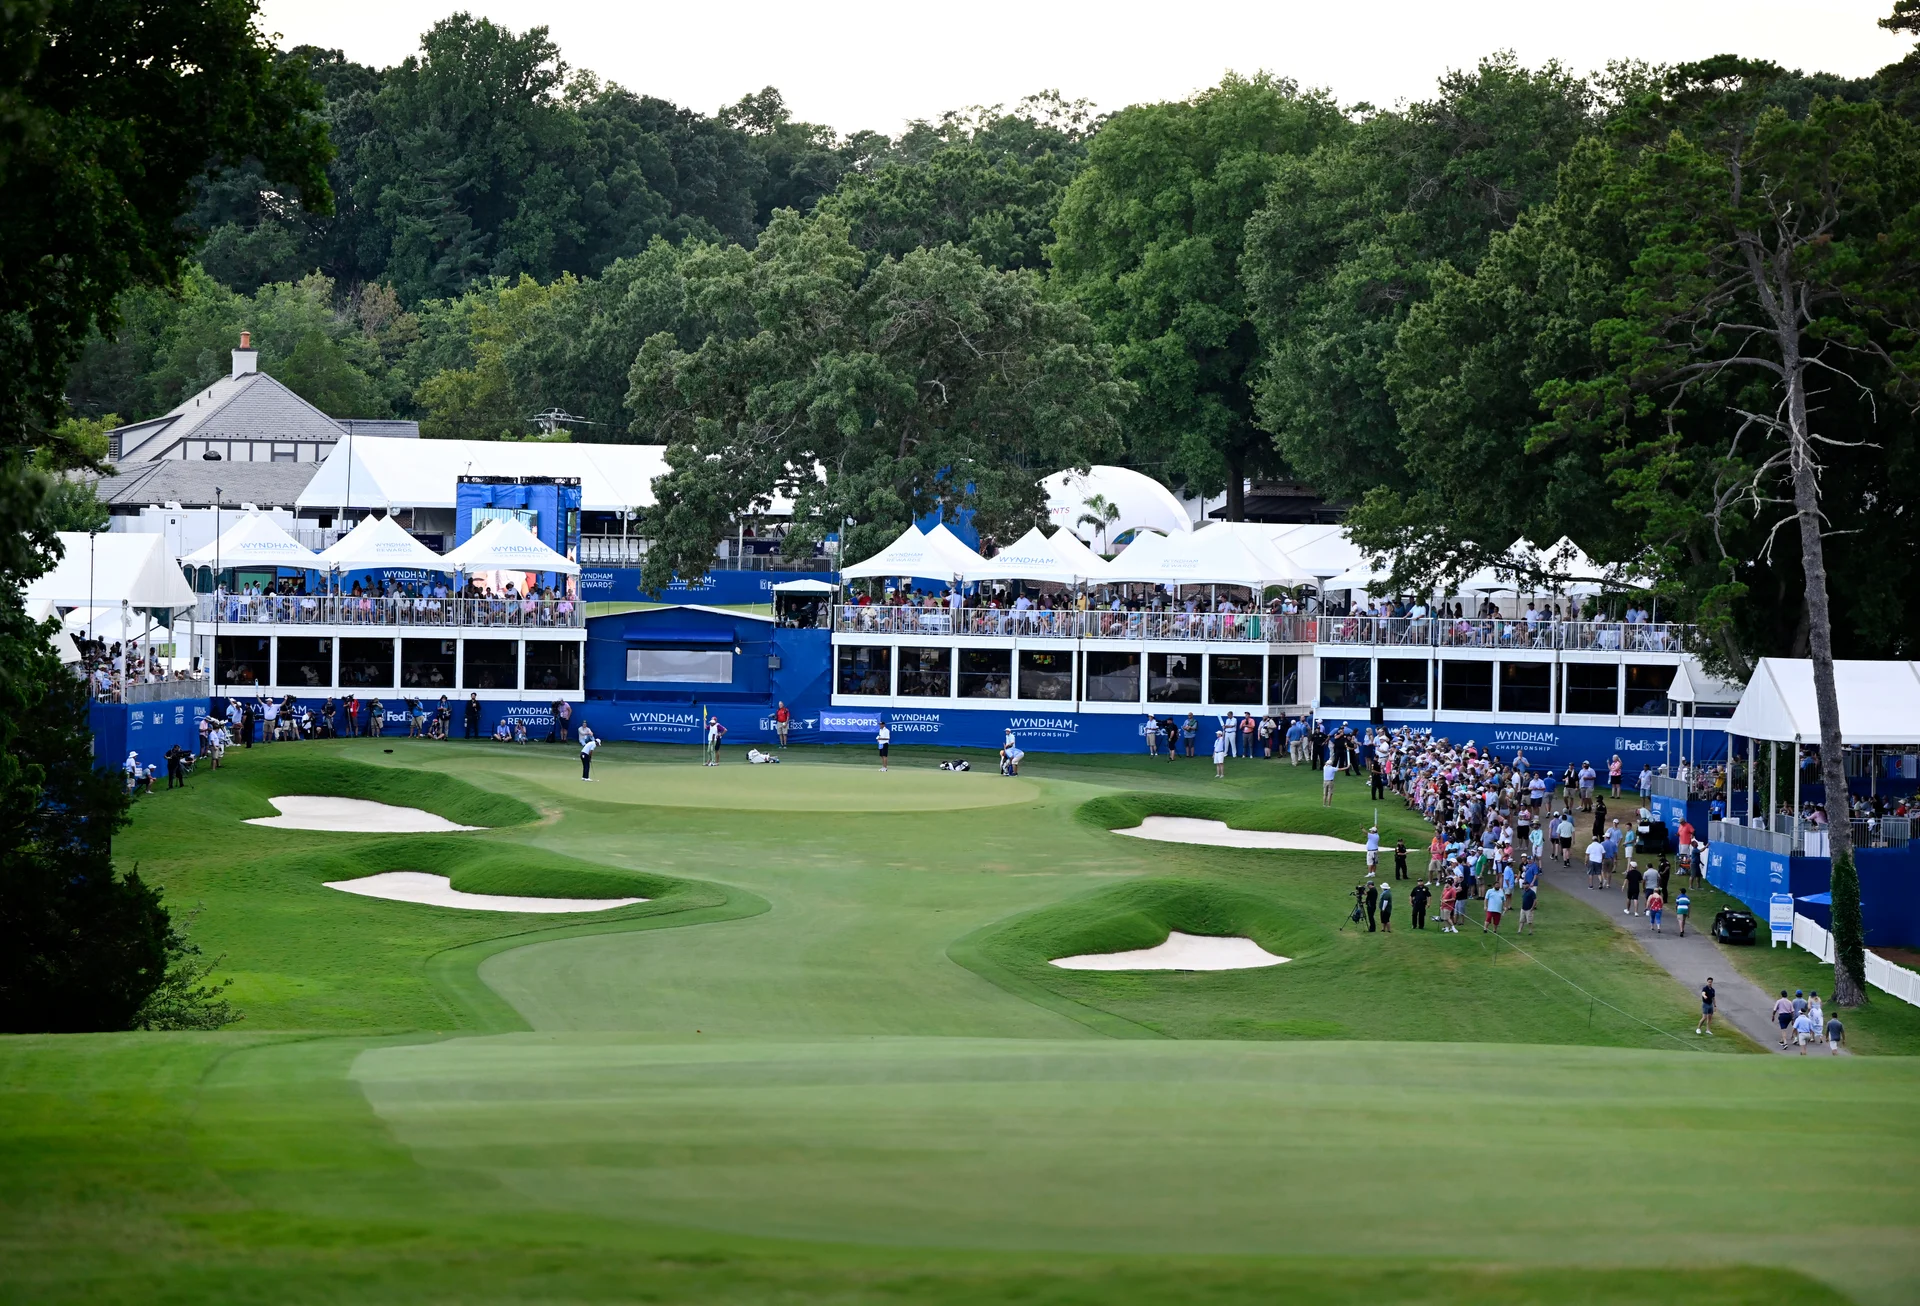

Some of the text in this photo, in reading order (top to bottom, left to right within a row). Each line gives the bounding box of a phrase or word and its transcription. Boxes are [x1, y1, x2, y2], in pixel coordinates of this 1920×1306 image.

[999, 556, 1054, 564] WYNDHAM
[630, 712, 694, 723] WYNDHAM
[831, 717, 878, 726] CBS SPORTS
[891, 713, 940, 722] WYNDHAM
[1010, 718, 1073, 728] WYNDHAM
[891, 724, 939, 732] REWARDS
[1494, 730, 1554, 742] WYNDHAM
[1624, 739, 1656, 751] FedEx
